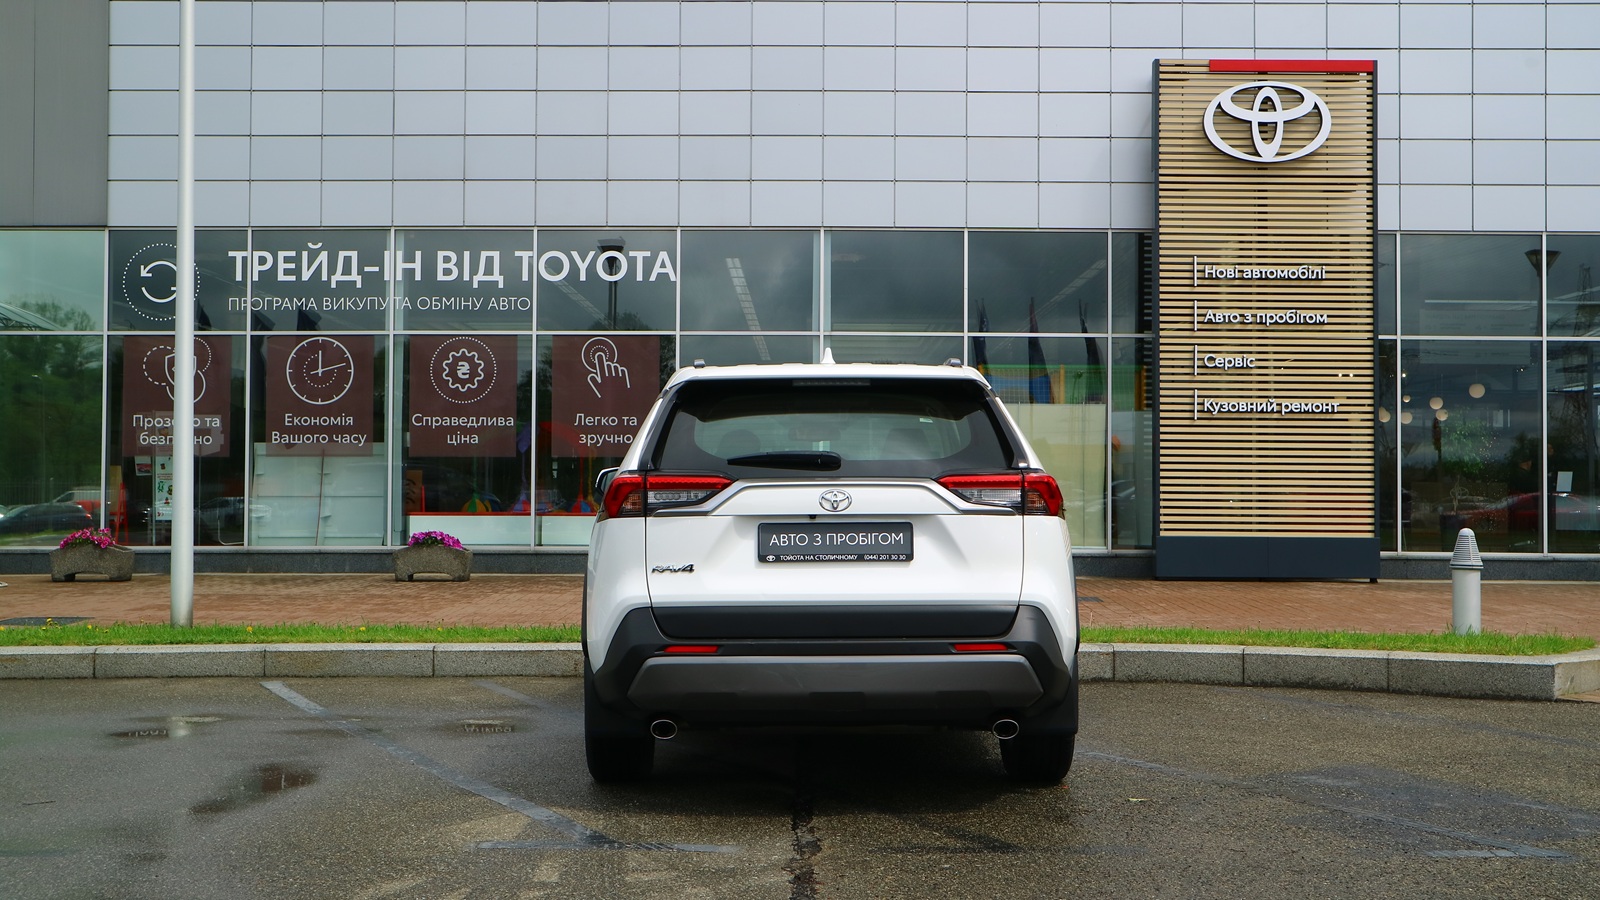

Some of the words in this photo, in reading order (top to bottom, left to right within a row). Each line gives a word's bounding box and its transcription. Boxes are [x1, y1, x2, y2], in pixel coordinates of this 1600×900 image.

[228, 242, 421, 289] ТРЕЙД-ІН
[437, 250, 504, 289] ВІД
[514, 250, 677, 282] TOYOTA
[1204, 265, 1239, 279] Нові
[1243, 265, 1326, 279] автомобілі
[228, 297, 318, 311] ПРОГРАМА
[323, 296, 389, 310] ВИКУПУ
[393, 296, 412, 310] ТА
[417, 296, 484, 310] ОБМІНУ
[487, 297, 531, 311] АВТО
[1204, 310, 1240, 323] Авто
[1243, 312, 1253, 323] з
[1256, 310, 1328, 326] пробігом
[1204, 354, 1256, 370] Сервіс
[1204, 398, 1277, 415] Кузовний
[1281, 401, 1340, 416] ремонт
[132, 414, 201, 430] Прозо
[204, 417, 220, 427] та
[284, 413, 354, 426] Економія
[411, 413, 515, 429] Справедлива
[574, 413, 619, 426] Легко
[621, 416, 638, 426] та
[140, 431, 213, 445] безпно
[271, 431, 329, 444] Вашого
[333, 434, 367, 447] часу
[447, 431, 479, 446] ціна
[579, 434, 634, 447] зручно
[769, 533, 809, 546] АВТО
[813, 533, 822, 546] З
[826, 532, 904, 546] ПРОБІГОМ
